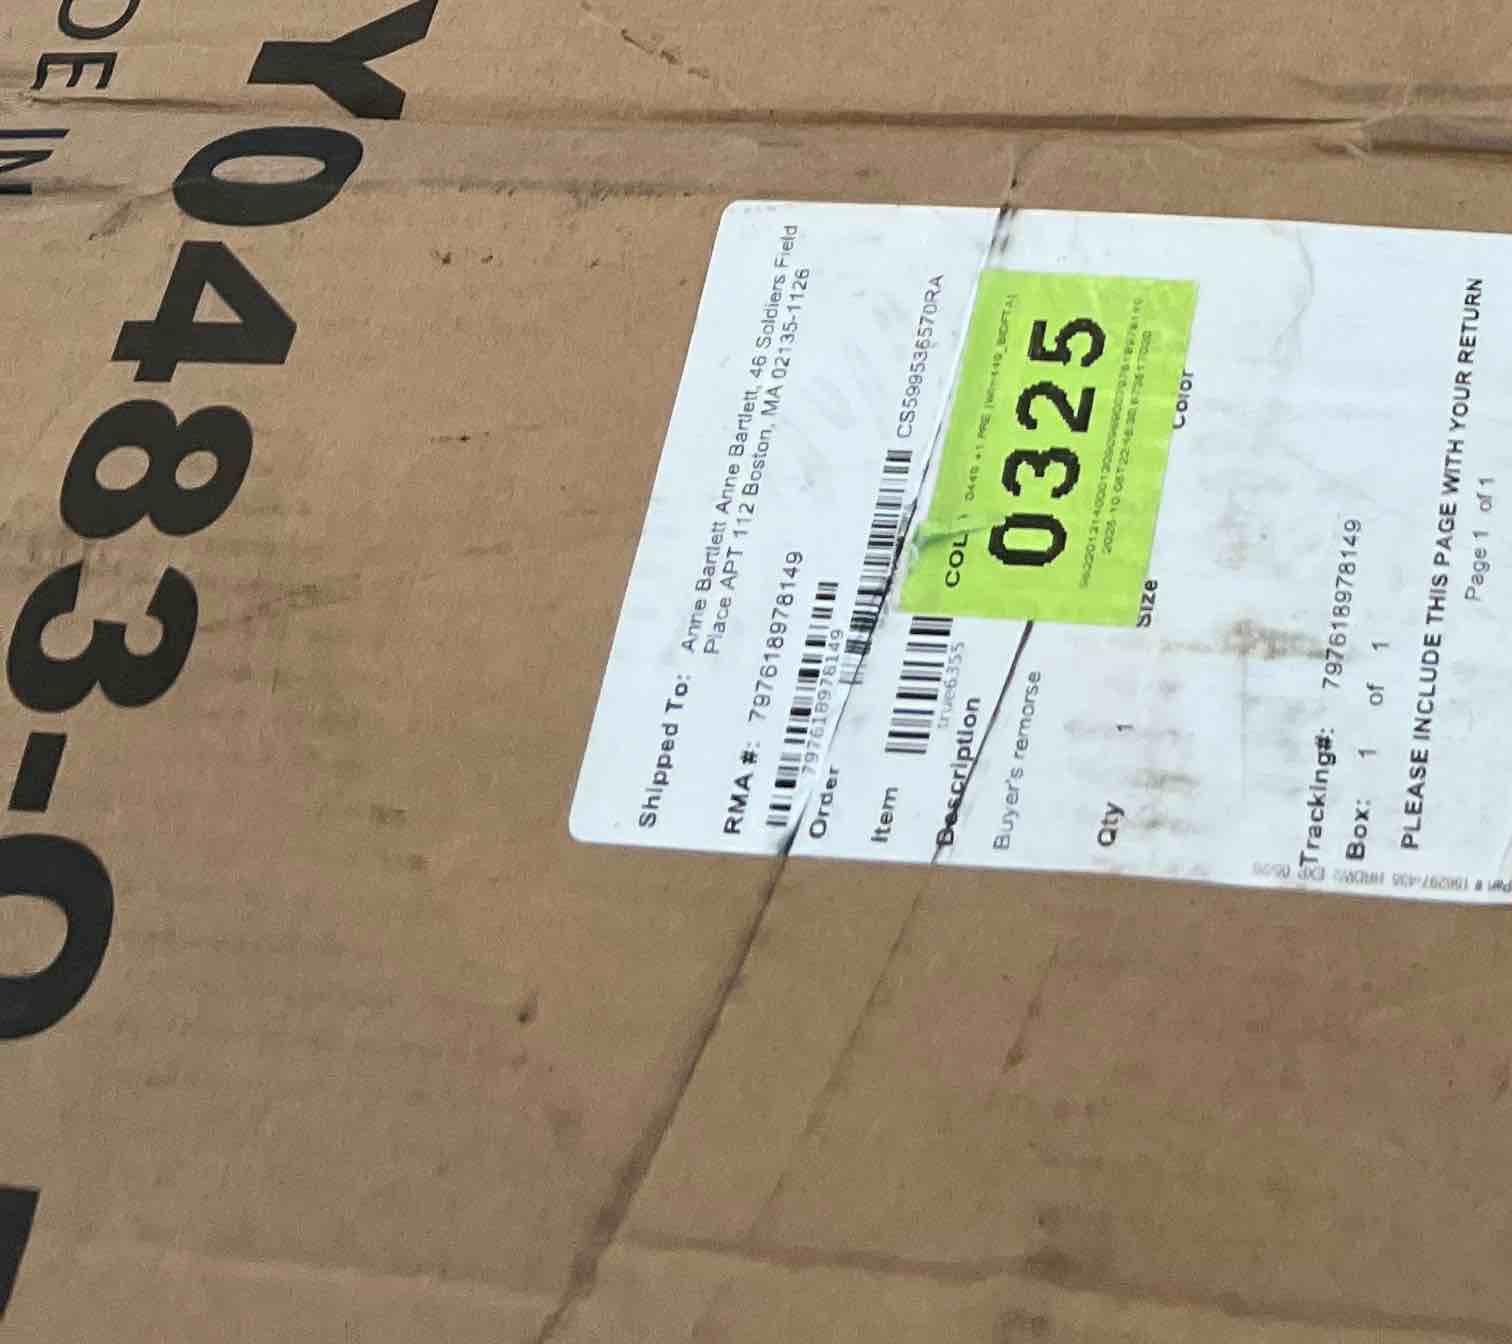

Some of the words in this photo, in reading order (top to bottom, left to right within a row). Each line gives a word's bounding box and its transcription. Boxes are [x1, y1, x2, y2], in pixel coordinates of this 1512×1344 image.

[774, 224, 799, 269] Field
[756, 270, 786, 350] Soldiers
[771, 267, 811, 380] 02135-1126
[1457, 277, 1483, 365] RETURN
[750, 355, 767, 380] 46
[728, 385, 763, 458] Bartlett,
[761, 385, 783, 417] MA
[1449, 369, 1473, 434] YOUR
[742, 424, 775, 496] Boston,
[988, 317, 1107, 567] 0325
[1441, 438, 1465, 497] WITH
[716, 462, 742, 515] Anne
[1476, 491, 1494, 514] of
[1478, 475, 1496, 486] 1
[733, 502, 756, 539] 112
[1433, 502, 1457, 568] PAGE
[1473, 528, 1490, 541] 1
[695, 520, 726, 593] Bartlett
[720, 546, 744, 591] APT
[808, 765, 840, 840] Order
[896, 272, 945, 440] CS599536570RA
[1464, 545, 1491, 603] Page
[680, 599, 707, 654] Anne
[703, 598, 732, 655] Place
[1136, 578, 1159, 629] Size
[1426, 574, 1449, 625] THIS
[748, 551, 804, 724] 797618978149
[1371, 638, 1391, 654] 1
[802, 628, 844, 777] 797618978149
[1298, 726, 1338, 868] Tracking#:
[1321, 517, 1363, 690] 797618978149
[1366, 680, 1386, 708] of
[1412, 632, 1442, 742] INCLUDE
[638, 722, 678, 829] Shipped
[665, 673, 692, 714] To:
[740, 740, 761, 766] #:
[934, 695, 981, 848] Description
[992, 766, 1024, 851] Buyer's
[1014, 670, 1042, 761] remorse
[1358, 746, 1378, 760] 1
[723, 772, 754, 835] RMA
[869, 786, 899, 844] Item
[1096, 800, 1126, 848] Qty
[1117, 722, 1134, 733] 1
[1401, 747, 1430, 851] PLEASE
[1345, 798, 1374, 862] Box:
